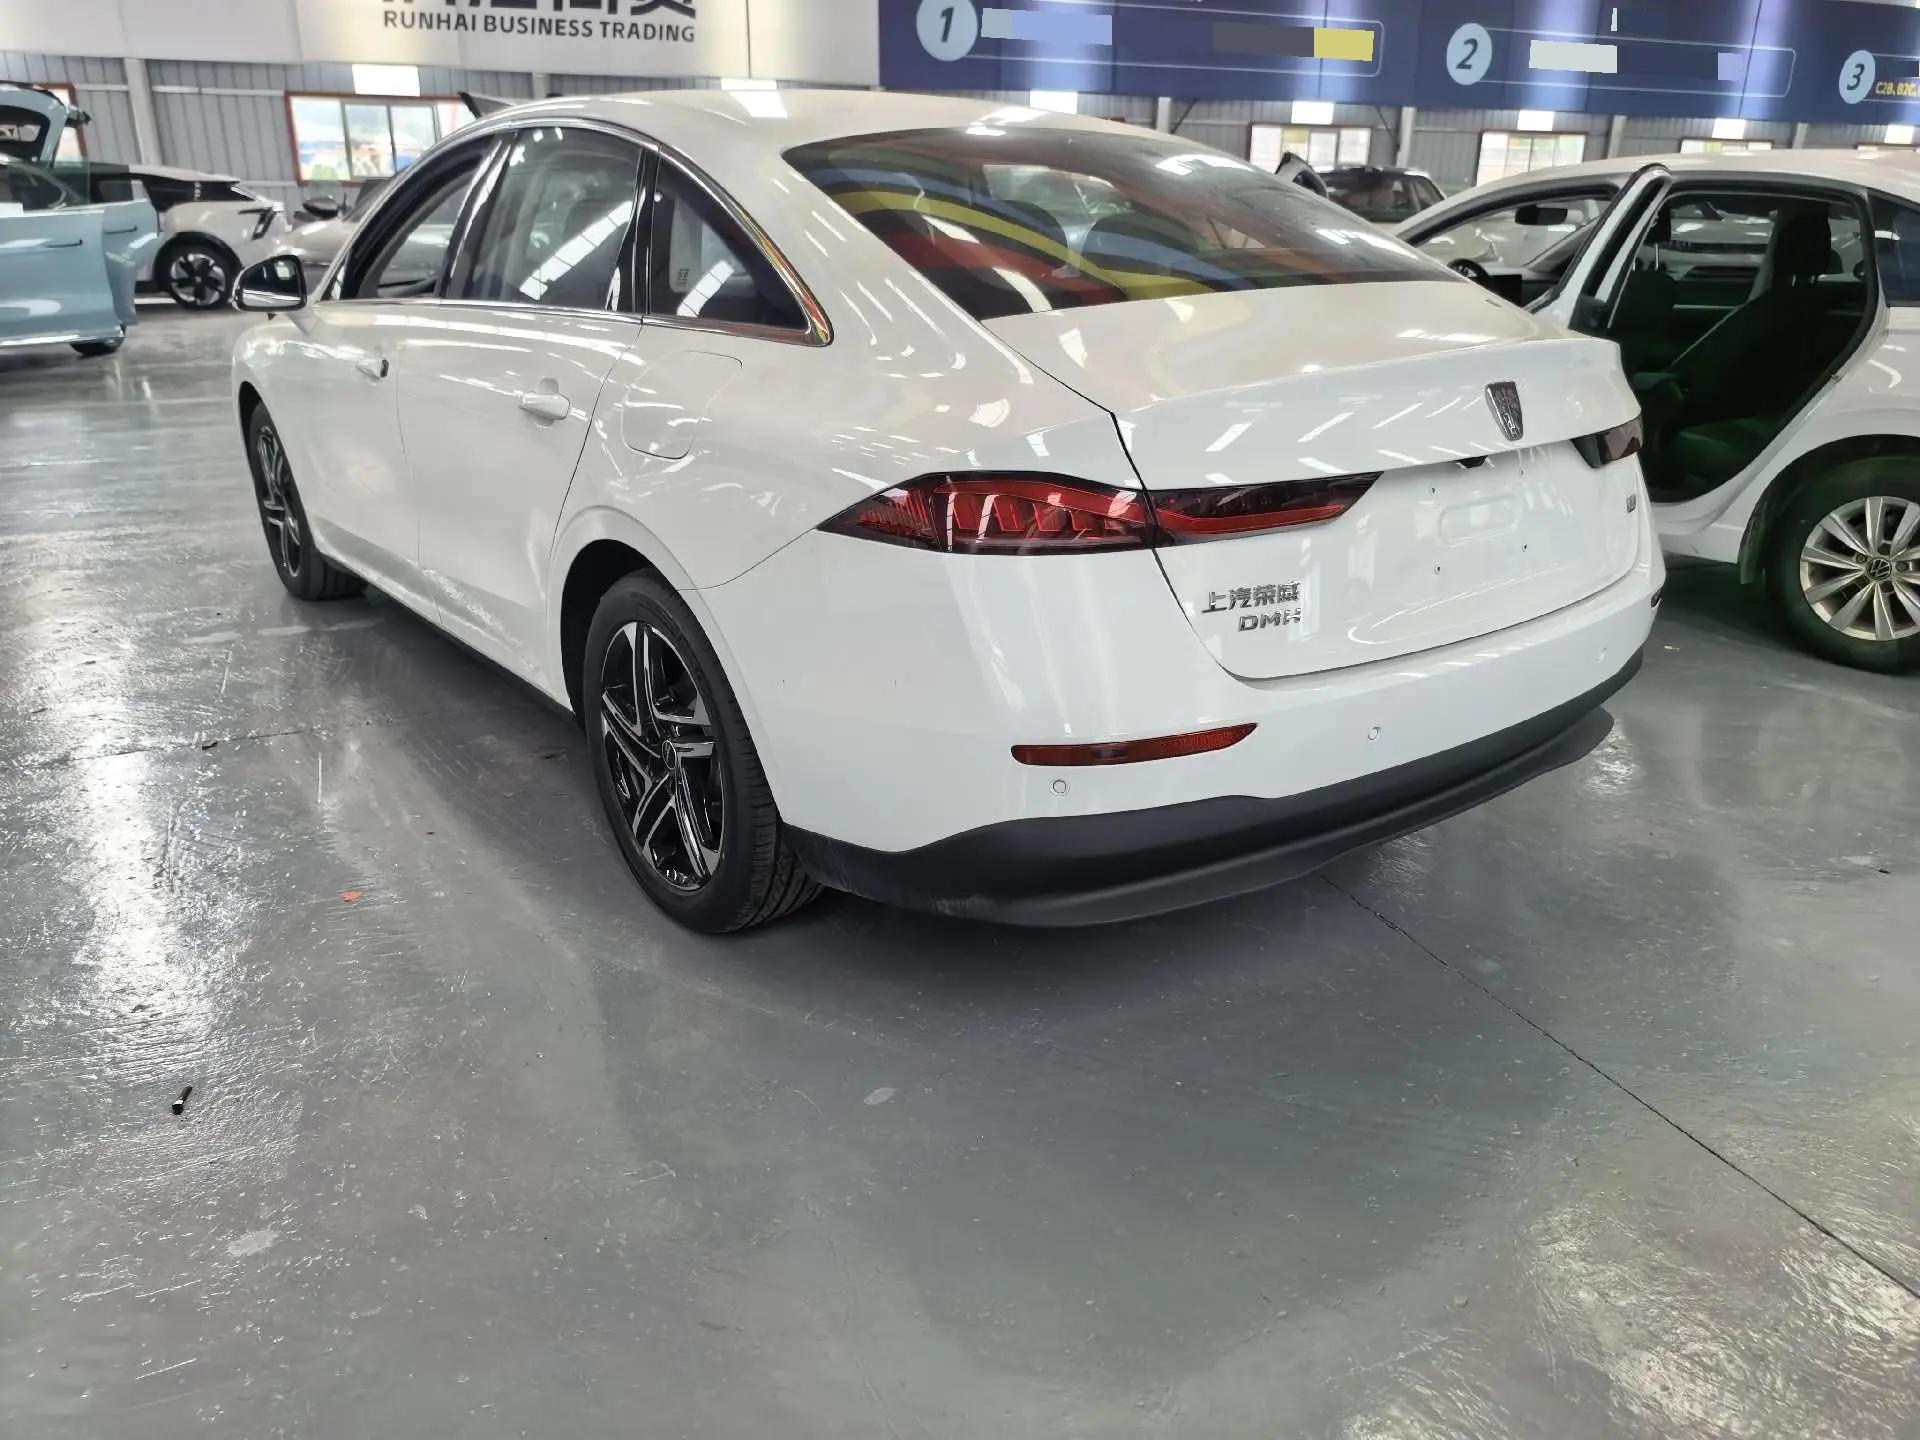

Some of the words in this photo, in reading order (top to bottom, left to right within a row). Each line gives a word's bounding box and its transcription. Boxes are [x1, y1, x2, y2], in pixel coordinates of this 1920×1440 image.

[383, 10, 477, 32] RUNHAI
[483, 14, 593, 38] BUSINESS
[599, 21, 696, 43] TRADING
[940, 6, 954, 43] 1
[1455, 37, 1478, 69] 2
[1846, 63, 1865, 91] 3
